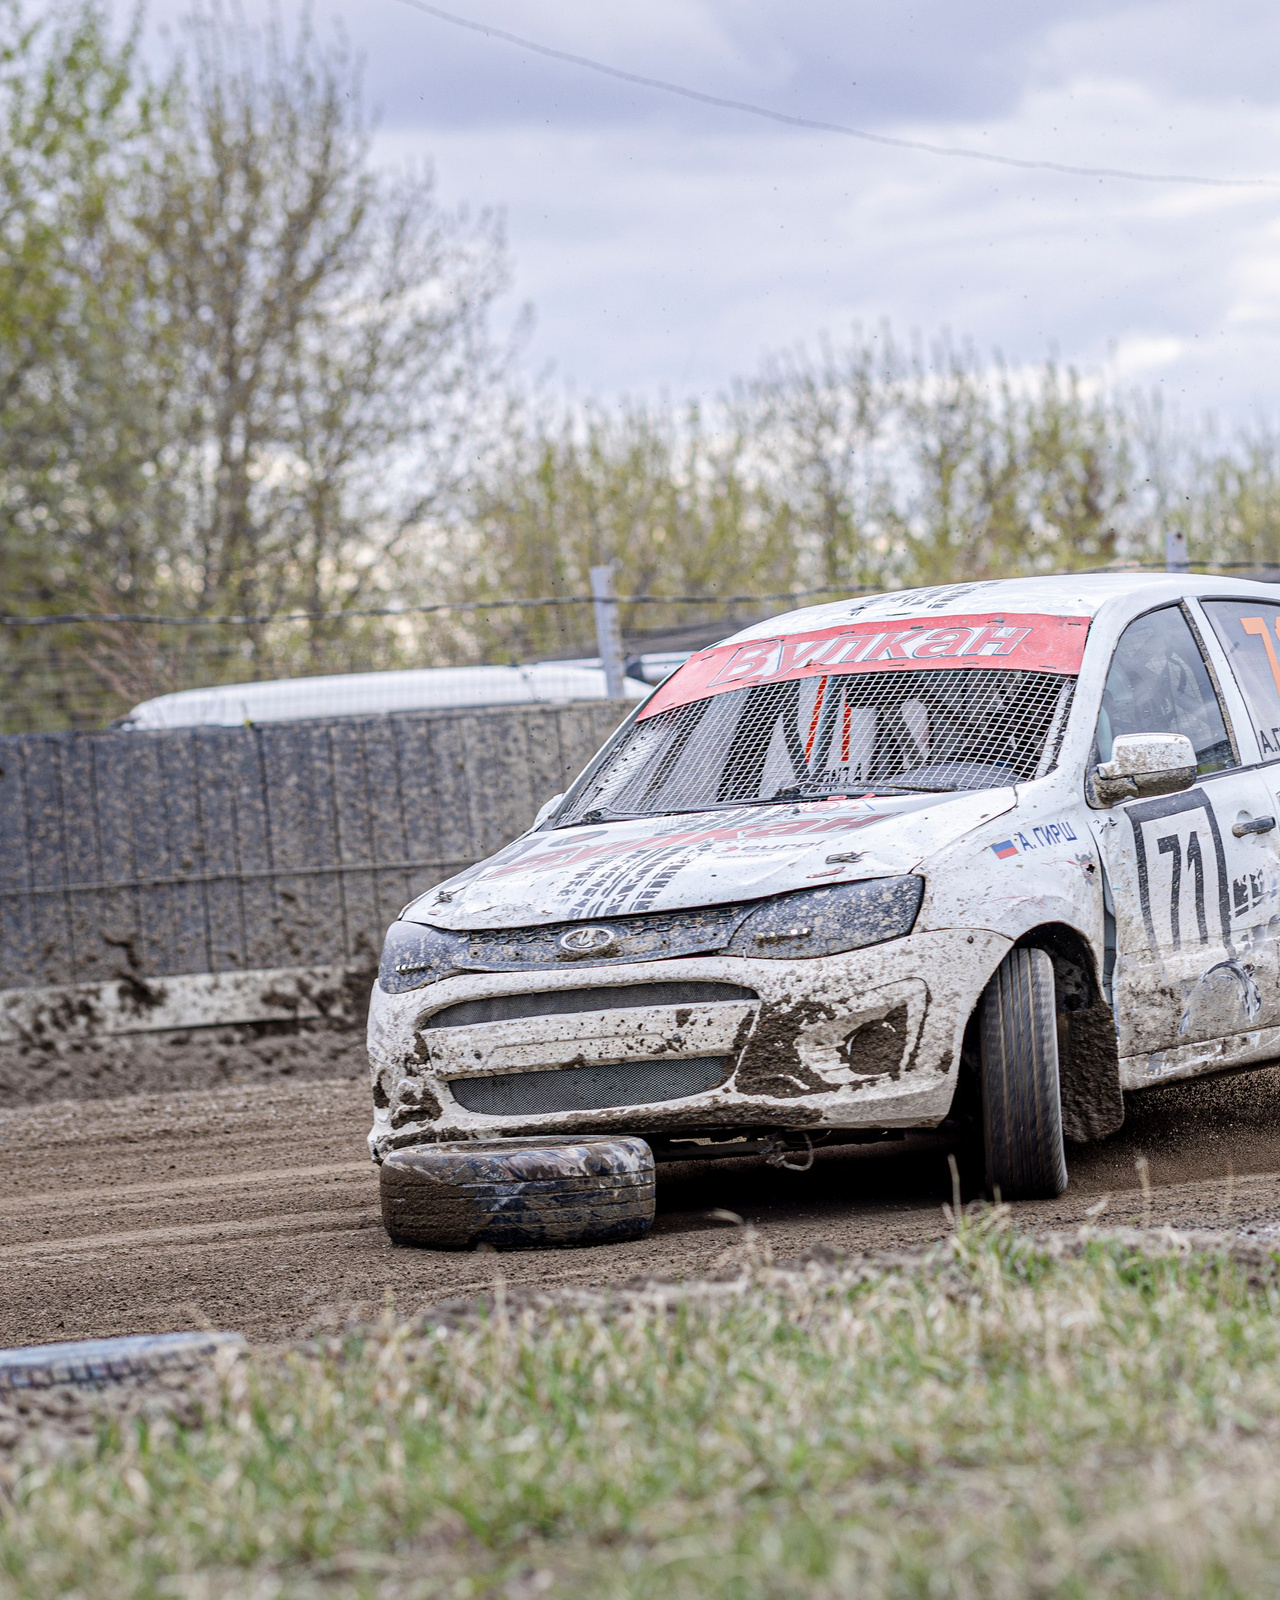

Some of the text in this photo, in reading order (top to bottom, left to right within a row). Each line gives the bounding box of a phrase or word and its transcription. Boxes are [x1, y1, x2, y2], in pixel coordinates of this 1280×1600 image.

[709, 627, 1033, 686] Вулкан
[1033, 822, 1077, 847] ГИРШ
[1156, 831, 1208, 949] 71
